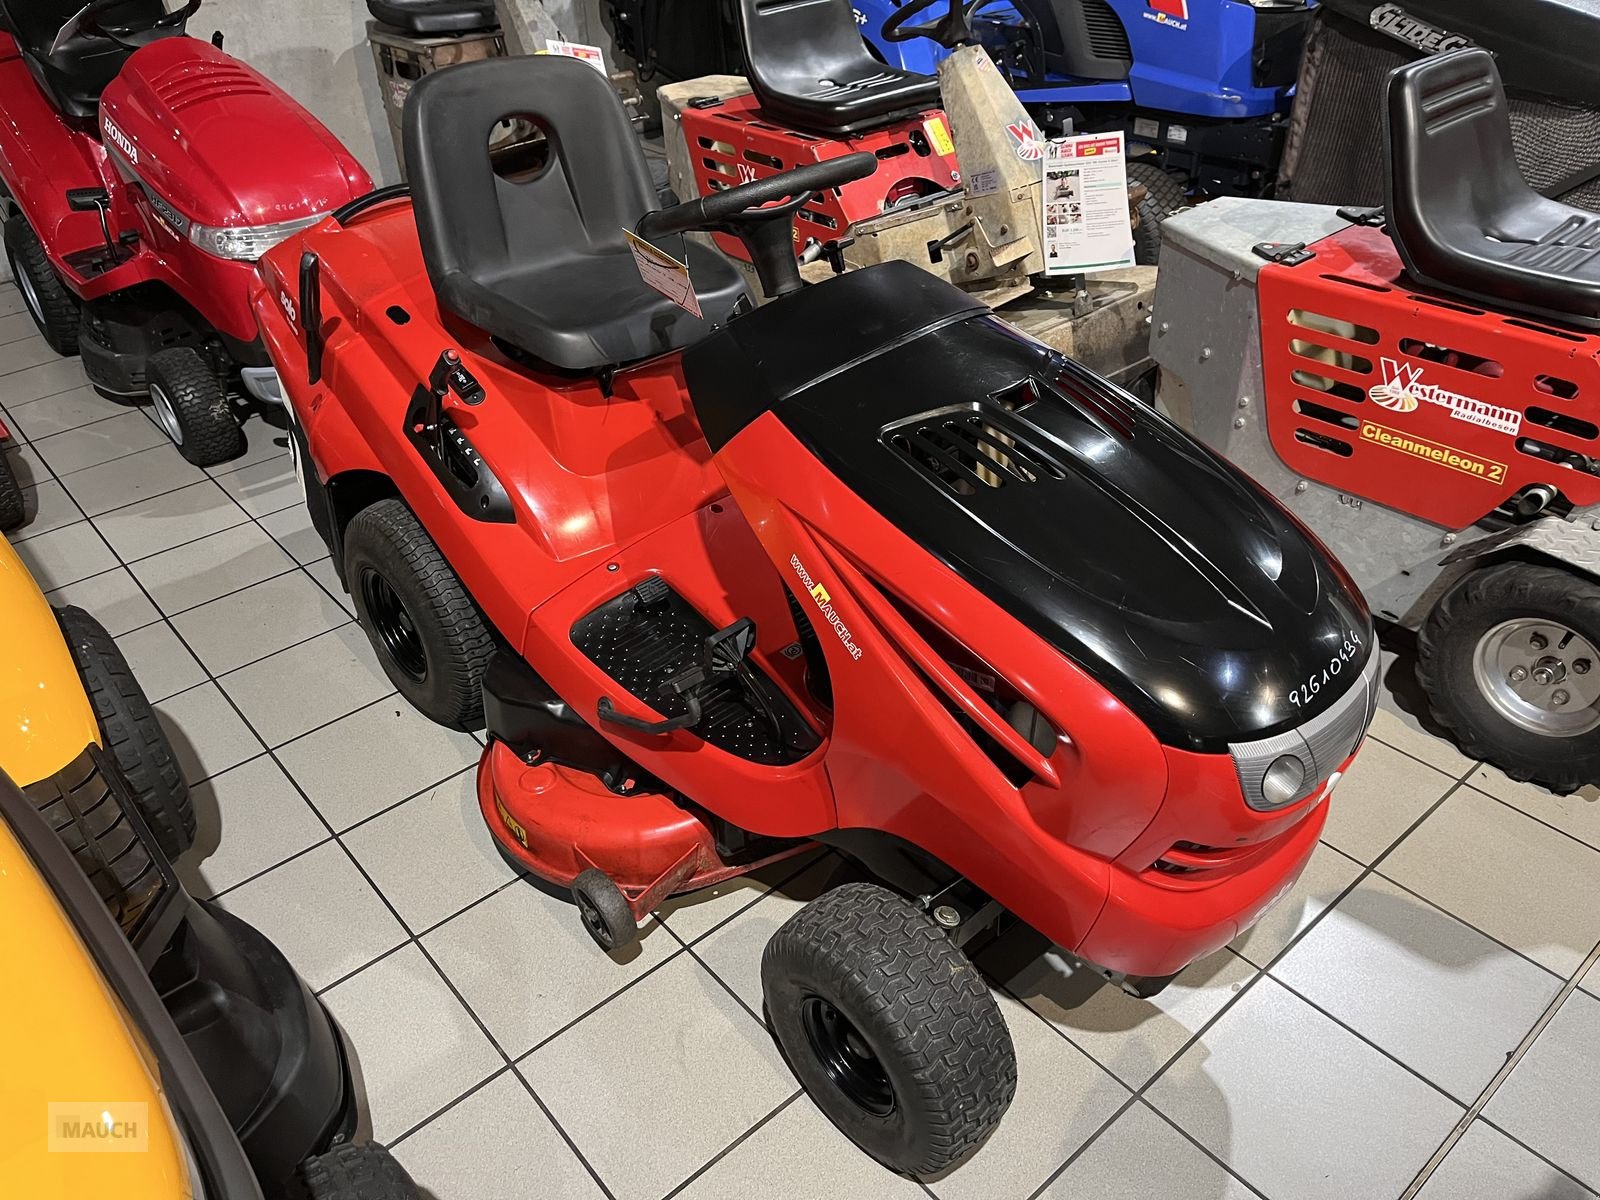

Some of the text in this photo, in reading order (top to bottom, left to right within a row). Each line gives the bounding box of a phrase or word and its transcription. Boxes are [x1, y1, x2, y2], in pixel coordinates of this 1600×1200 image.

[104, 117, 139, 164] HONDA
[1380, 356, 1520, 425] Westermann
[1453, 410, 1516, 433] Radialbesen
[1362, 424, 1503, 480] Cleanmeleon 2
[790, 554, 862, 660] www.MAUCH.at
[1288, 629, 1362, 707] 92610434
